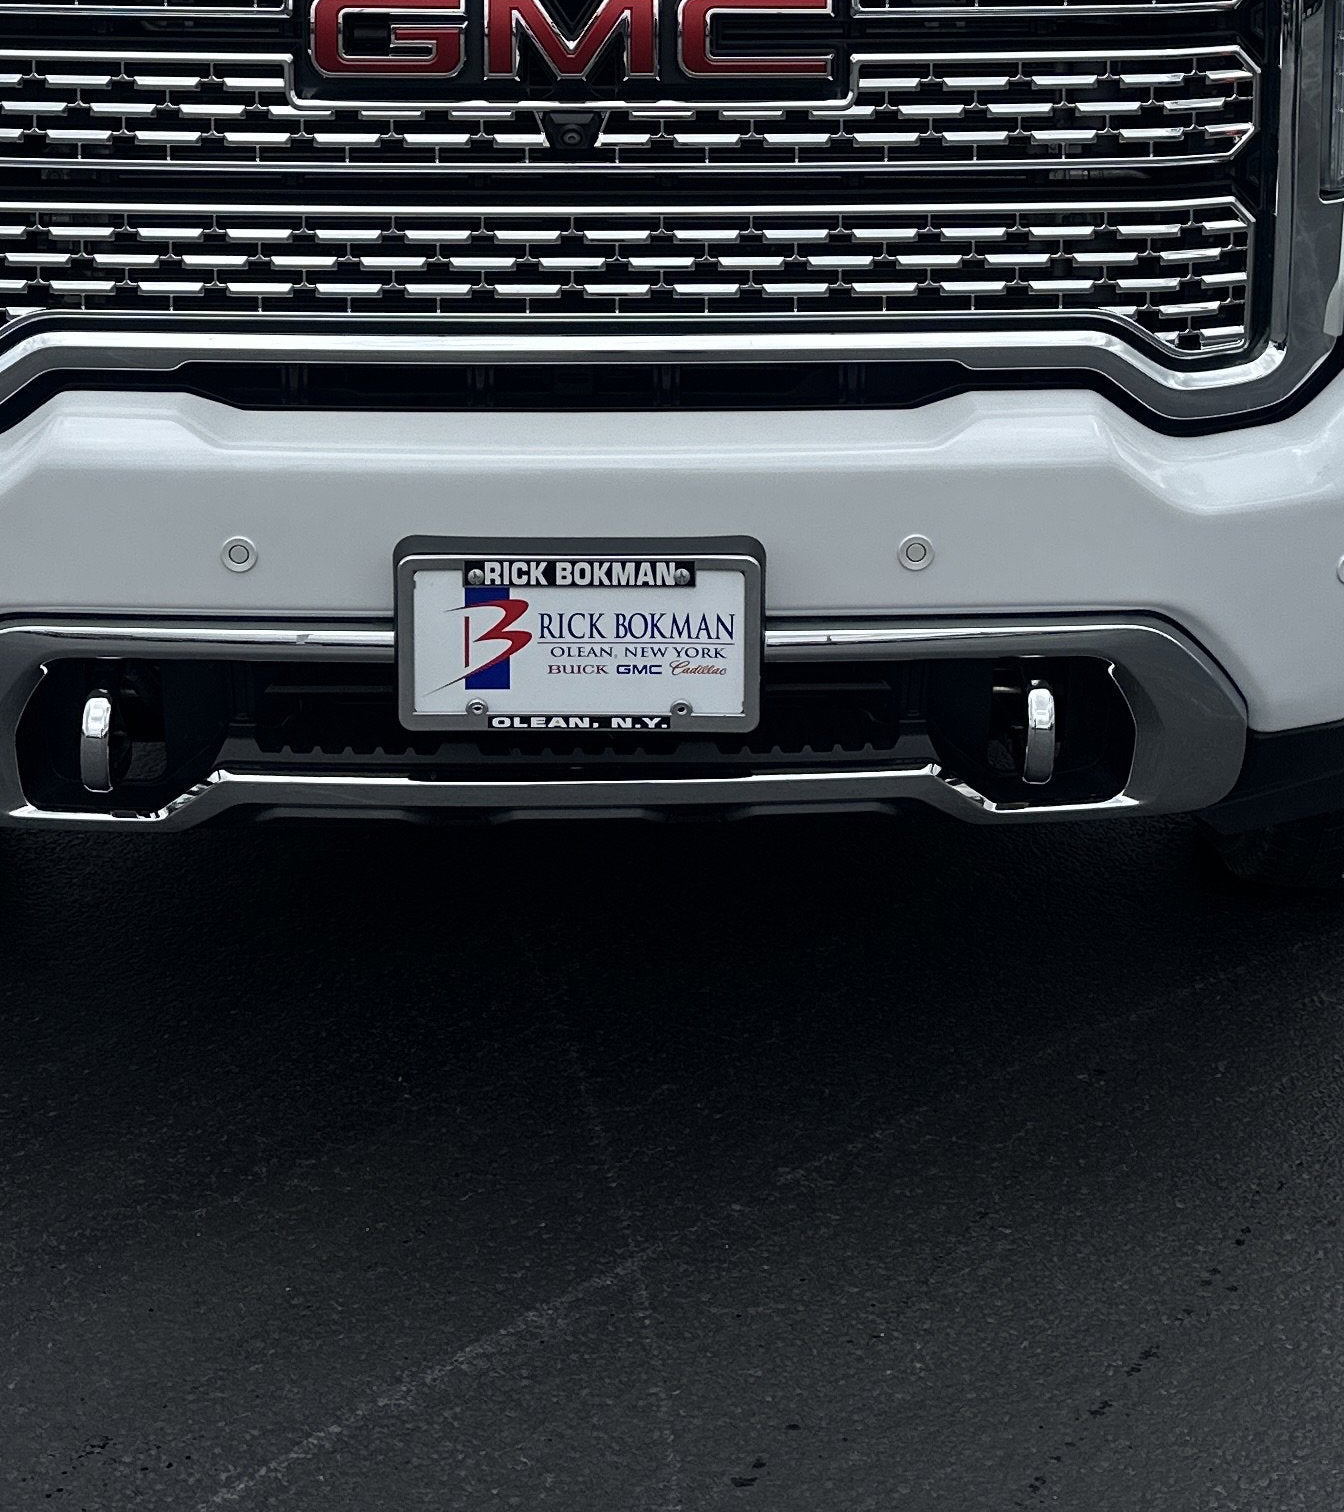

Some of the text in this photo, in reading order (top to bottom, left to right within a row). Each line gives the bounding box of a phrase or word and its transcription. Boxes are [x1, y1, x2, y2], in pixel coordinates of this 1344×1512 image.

[484, 561, 676, 586] RICK BOKMAN
[538, 612, 735, 641] RICK BOKMAN
[624, 646, 669, 659] NEW
[671, 646, 727, 659] YORK
[547, 660, 727, 676] BUICK GMC Cadillac
[491, 716, 669, 730] OLEAN, N.Y.
